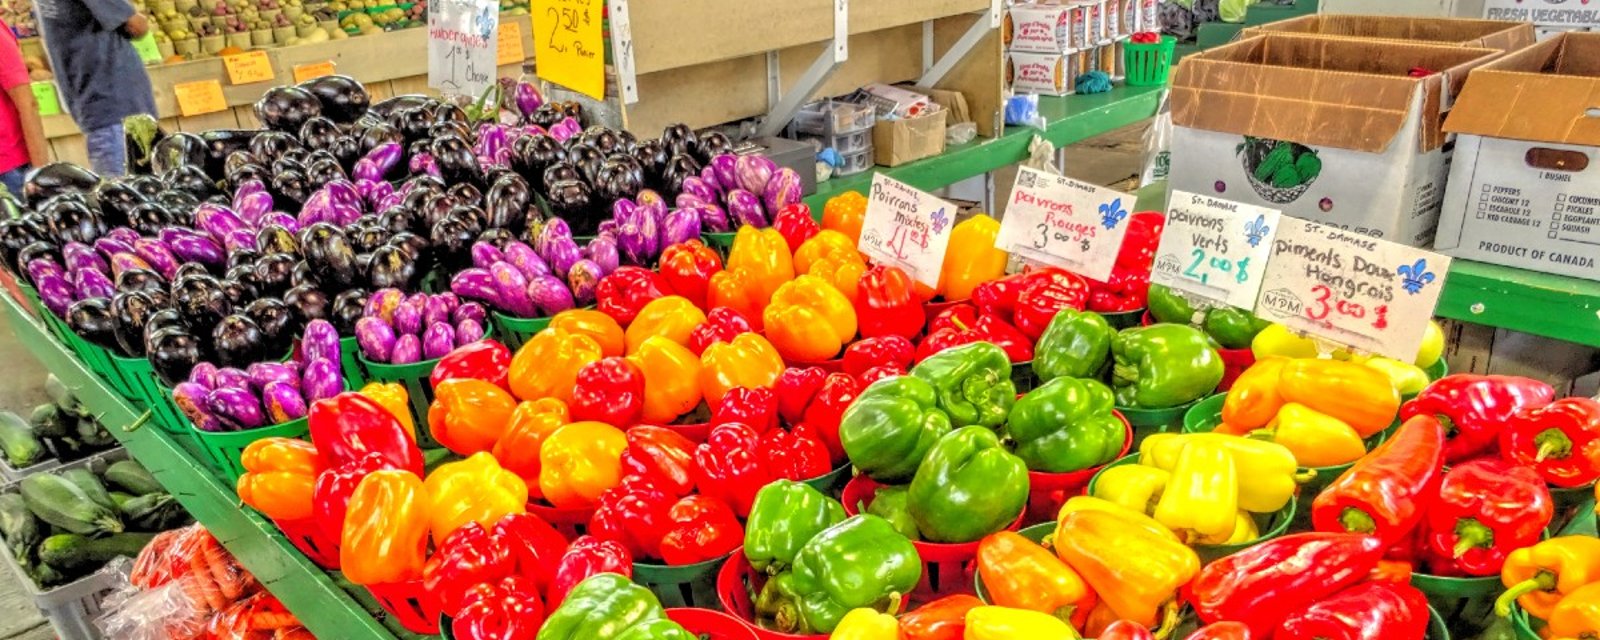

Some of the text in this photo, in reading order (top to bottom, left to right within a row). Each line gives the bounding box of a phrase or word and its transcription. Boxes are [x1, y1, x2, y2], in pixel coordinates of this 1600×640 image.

[1487, 7, 1529, 20] FRESH
[1539, 171, 1571, 182] 1 BUSHEL
[1492, 185, 1521, 196] PEPPERS
[1521, 199, 1531, 208] 12
[1488, 204, 1532, 217] ESCAROLE 12
[1566, 204, 1594, 216] PICKLES
[1532, 219, 1541, 228] 12
[1563, 214, 1600, 226] EGGPLANT
[1561, 223, 1591, 234] SQUASH
[1081, 238, 1091, 252] $
[1479, 241, 1595, 269] PRODUCT OF CANADA
[1235, 257, 1251, 284] $
[1353, 255, 1396, 281] Doux
[1371, 304, 1388, 329] $
